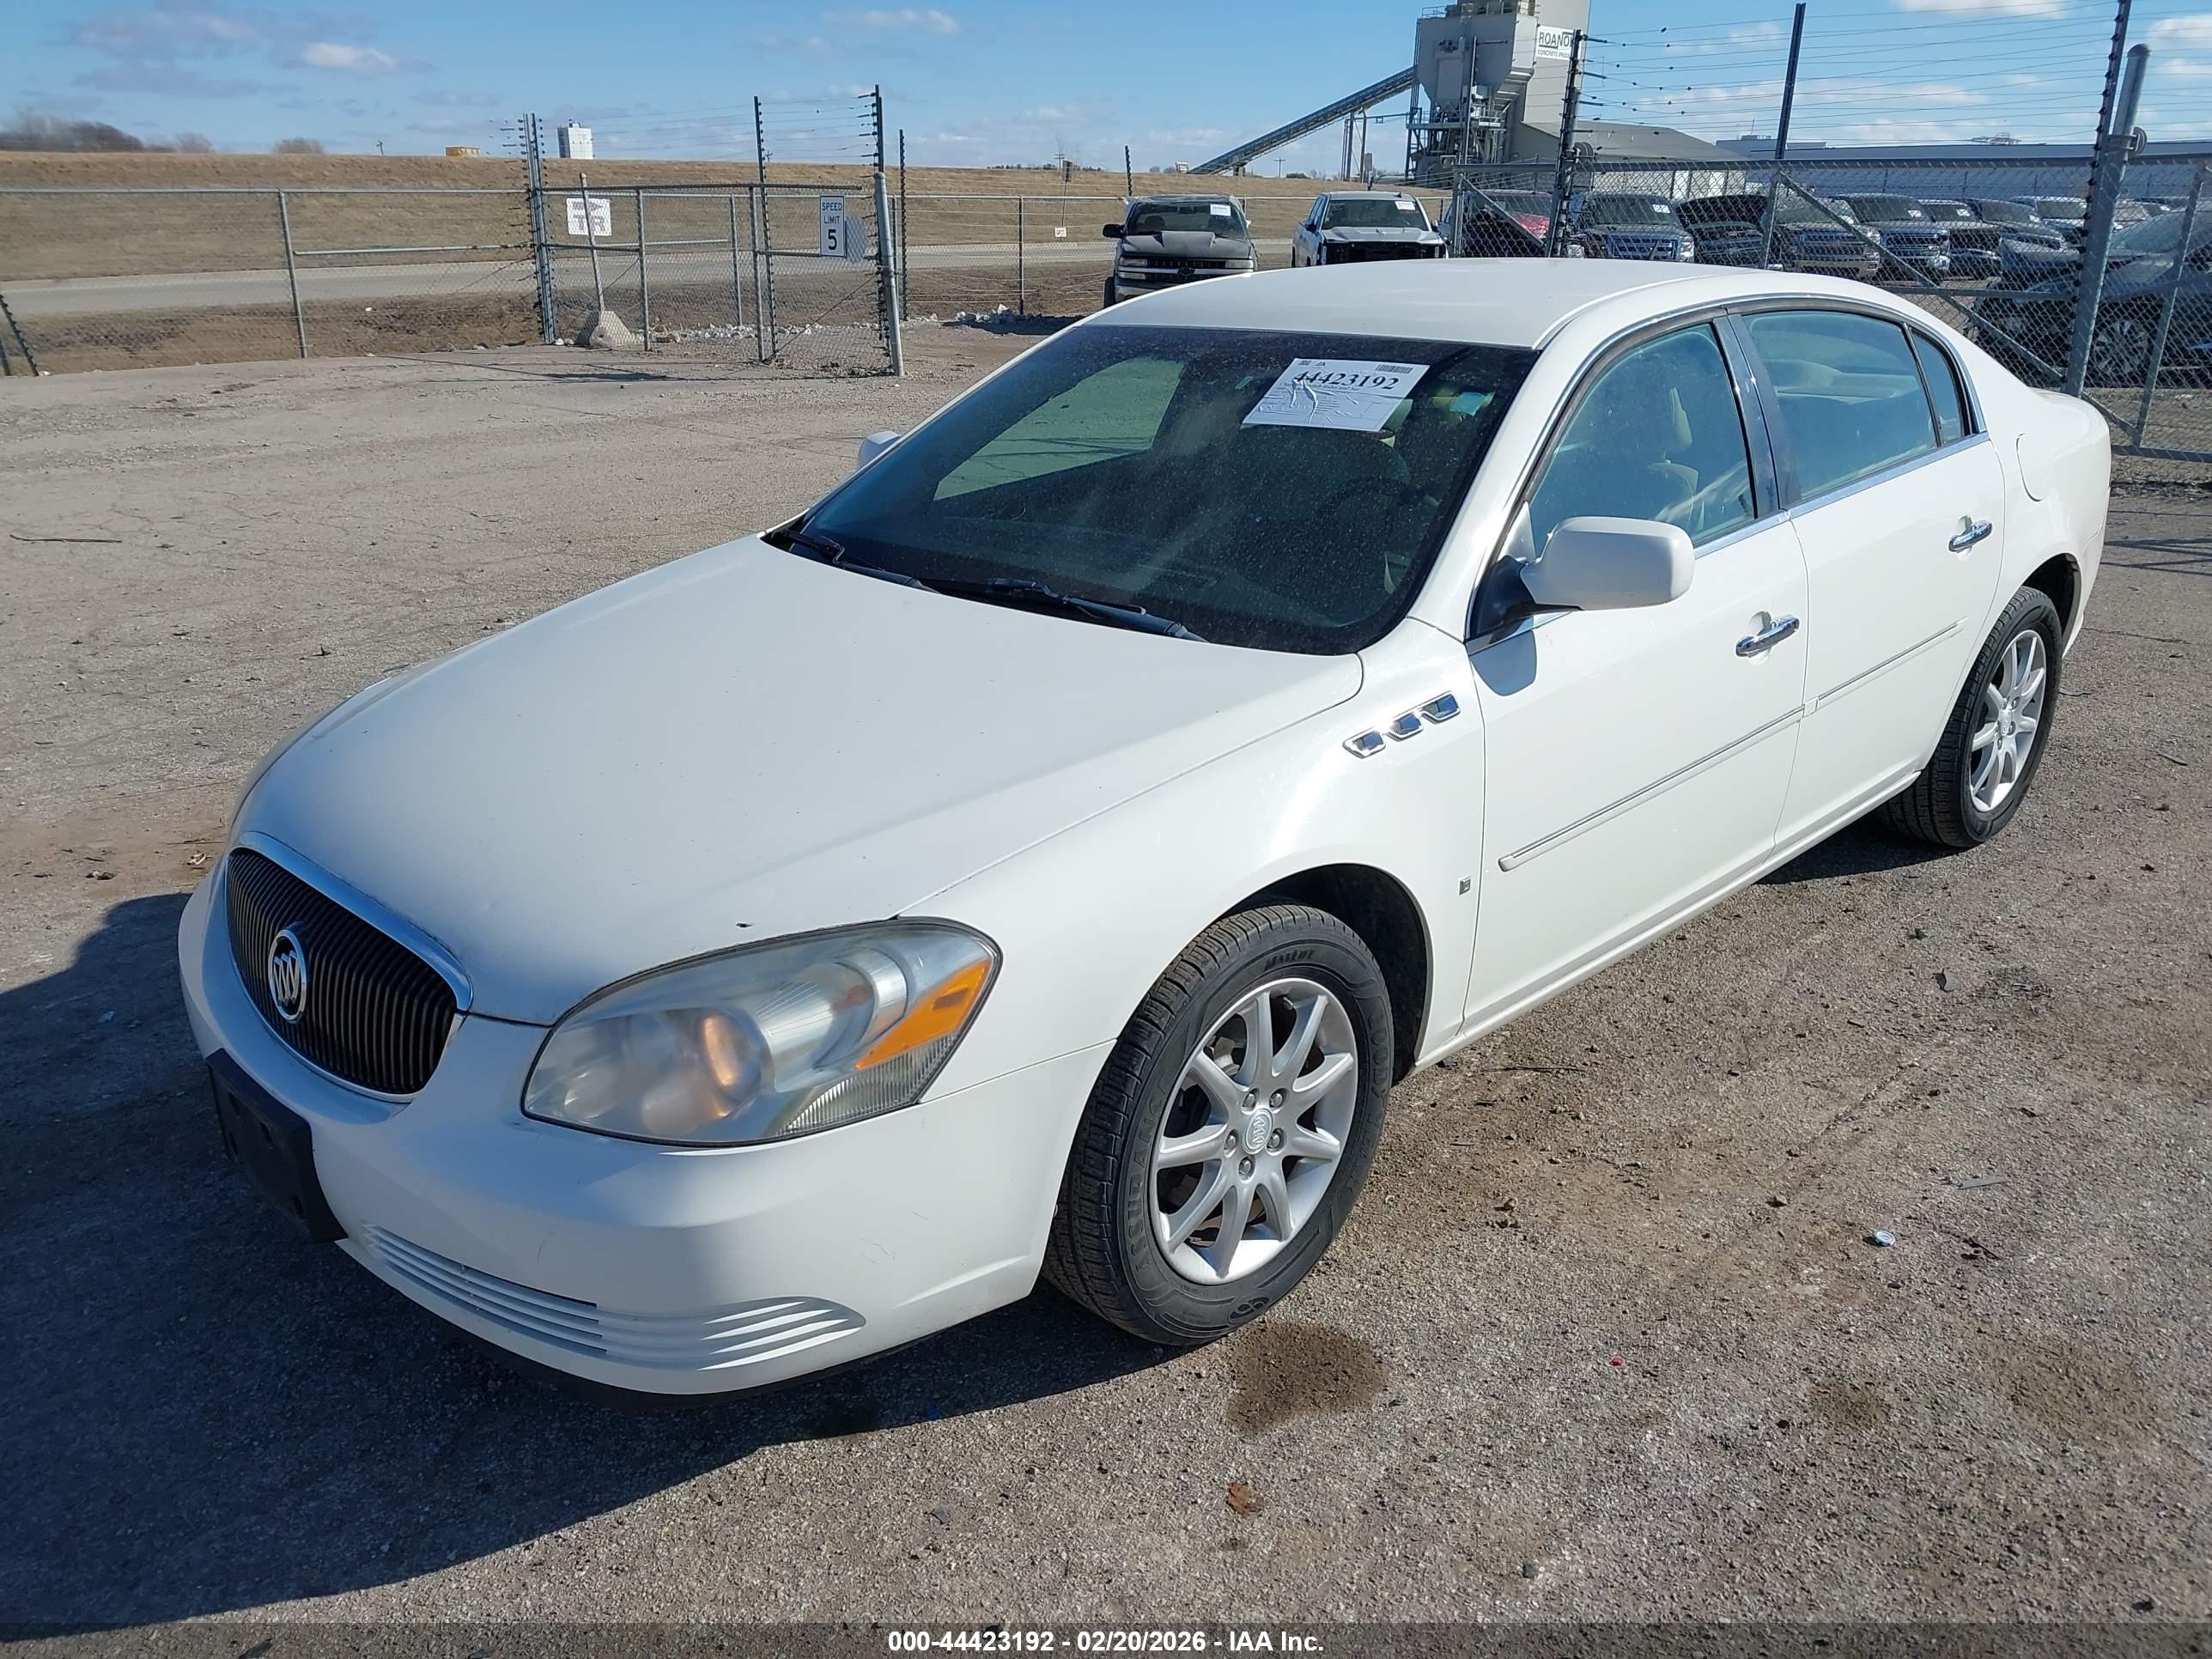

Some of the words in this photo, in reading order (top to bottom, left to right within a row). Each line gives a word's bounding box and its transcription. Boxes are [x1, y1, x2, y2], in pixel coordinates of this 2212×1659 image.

[822, 202, 842, 211] SPEED
[823, 215, 841, 224] LIMIT
[828, 228, 837, 251] 5
[1293, 371, 1400, 390] 44423192
